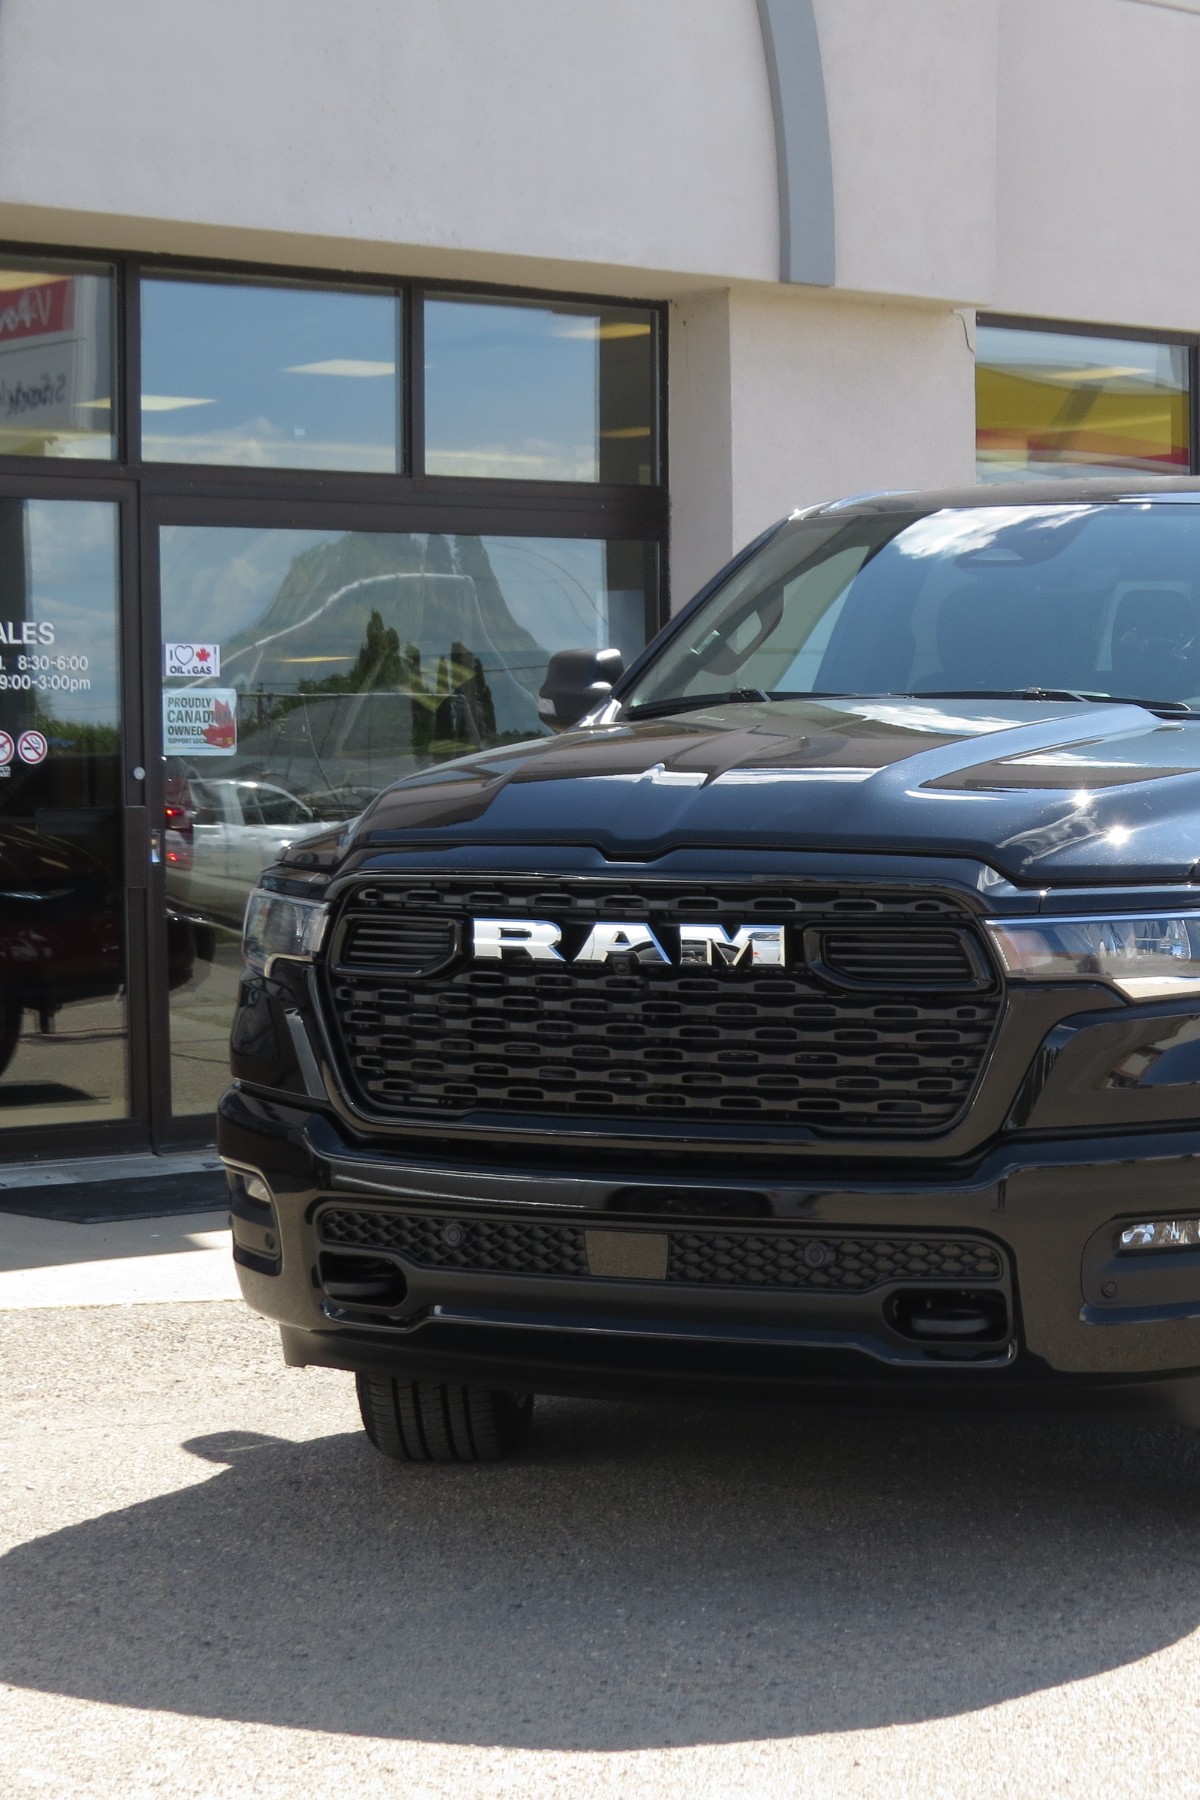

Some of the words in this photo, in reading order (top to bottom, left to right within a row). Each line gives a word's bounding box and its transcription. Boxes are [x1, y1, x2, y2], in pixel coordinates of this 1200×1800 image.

[18, 655, 89, 671] 8:30-6:00
[170, 665, 185, 674] OIL
[192, 665, 212, 675] GAS
[167, 697, 211, 708] PROUDLY
[168, 725, 203, 736] OWNED
[472, 918, 786, 967] RAM
